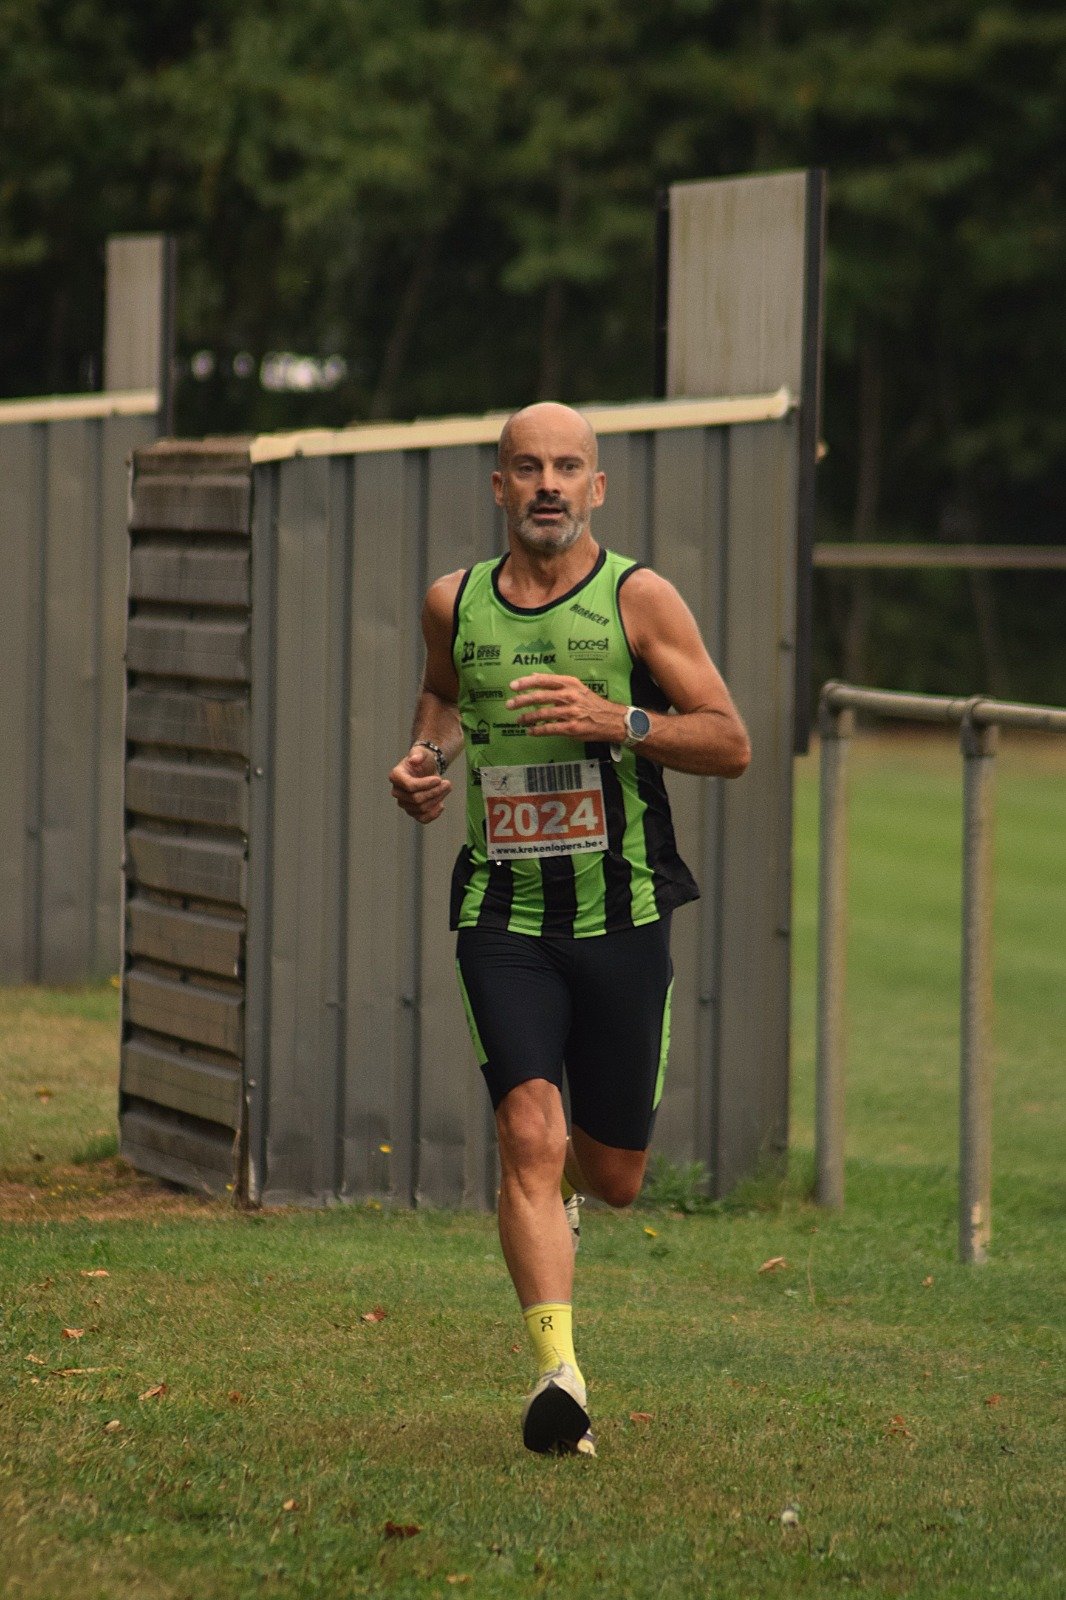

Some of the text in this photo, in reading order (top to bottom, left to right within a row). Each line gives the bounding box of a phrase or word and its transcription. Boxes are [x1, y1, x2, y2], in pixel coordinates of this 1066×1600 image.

[512, 653, 556, 665] Athlex
[492, 797, 599, 837] 2024
[496, 841, 597, 855] www.krekenlopers.be
